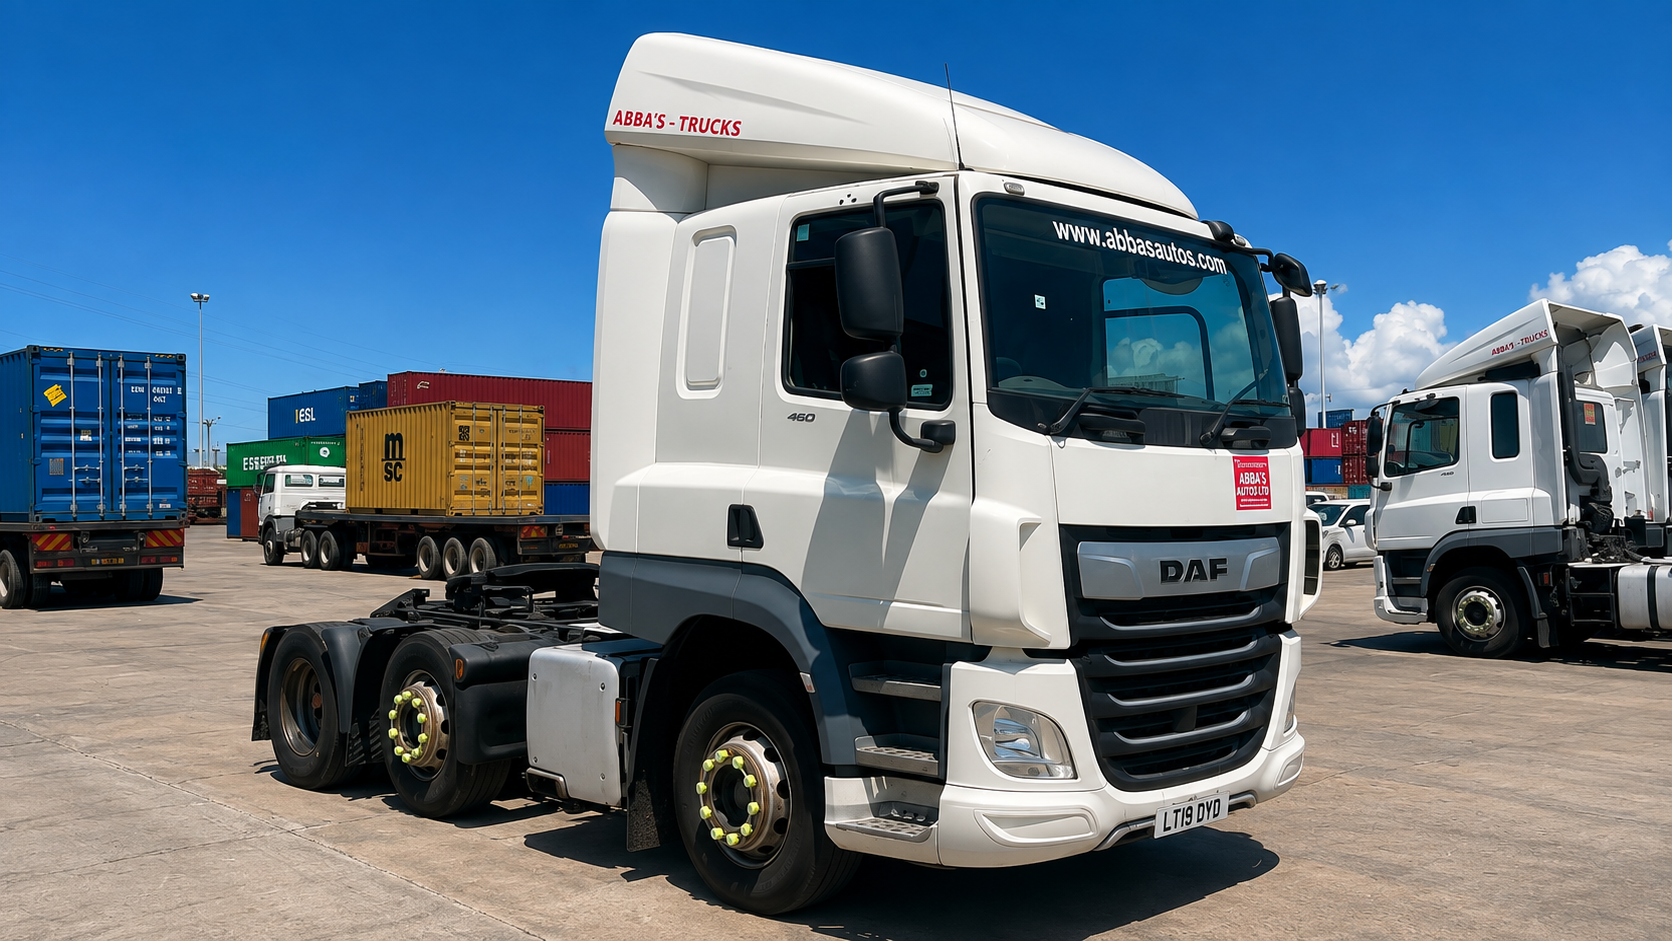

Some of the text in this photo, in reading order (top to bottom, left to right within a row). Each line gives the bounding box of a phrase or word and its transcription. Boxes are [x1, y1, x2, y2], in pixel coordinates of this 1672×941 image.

[613, 110, 666, 129] ABBA'S
[679, 116, 742, 137] TRUCKS
[1052, 220, 1228, 275] www.abbasautos.com
[787, 412, 816, 423] 460
[1160, 558, 1227, 583] DAF
[1163, 798, 1221, 832] LT19 DYD
